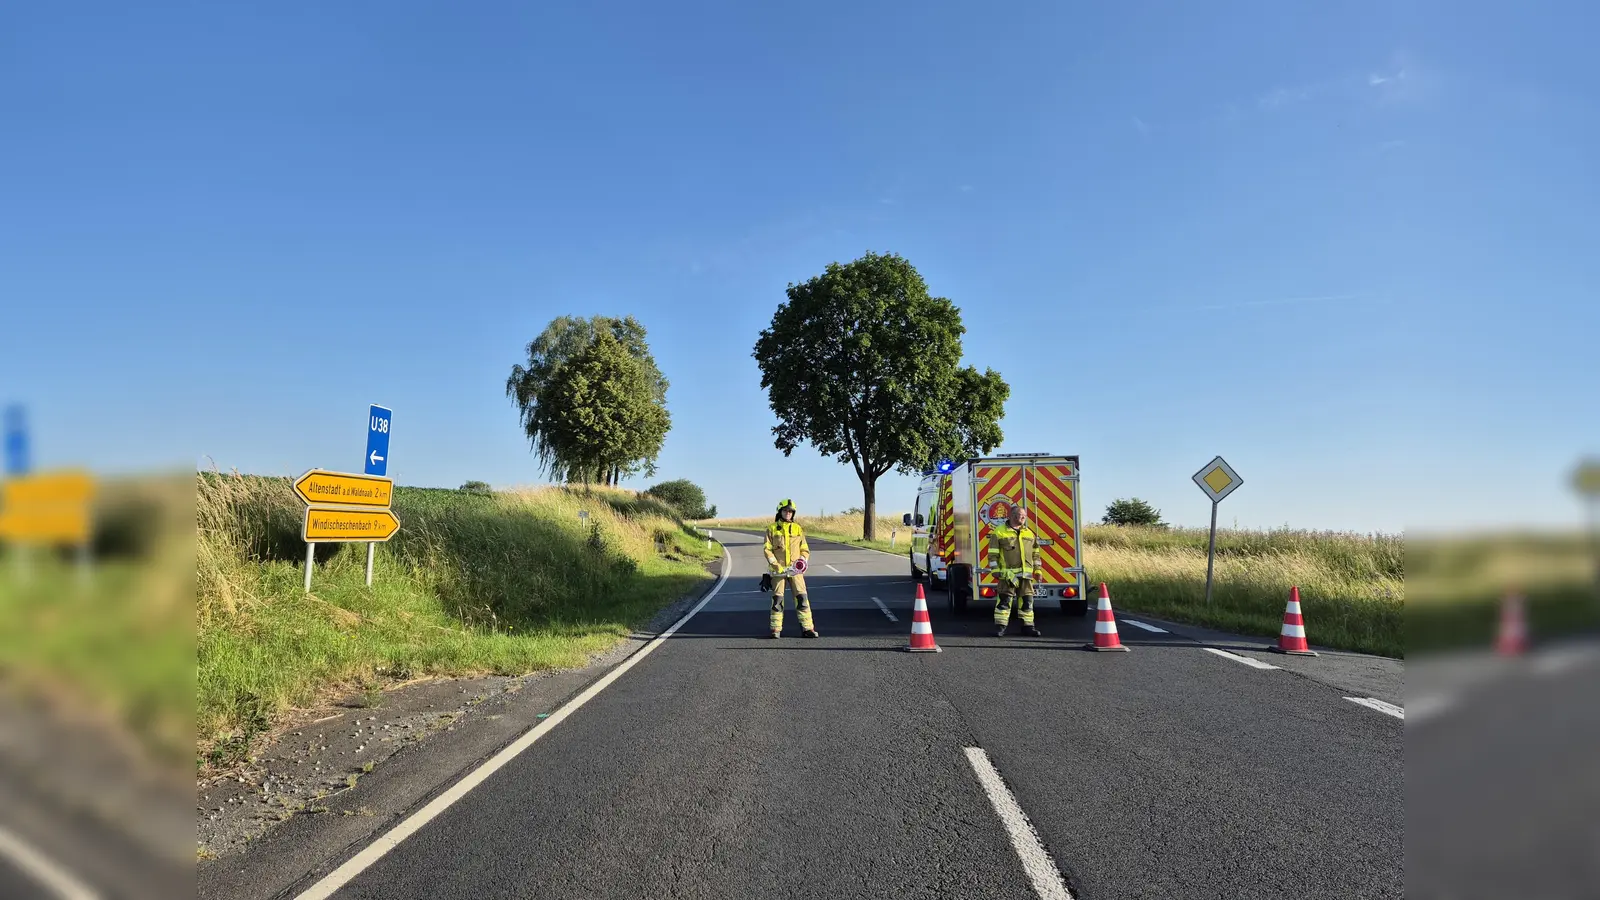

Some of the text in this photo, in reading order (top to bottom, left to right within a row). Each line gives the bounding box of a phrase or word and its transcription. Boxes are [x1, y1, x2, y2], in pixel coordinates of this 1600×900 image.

[371, 416, 388, 433] U38
[308, 482, 341, 495] Altenstadt
[375, 487, 379, 498] 2
[379, 490, 387, 499] km
[313, 518, 386, 530] Windischeschenbach 9 km
